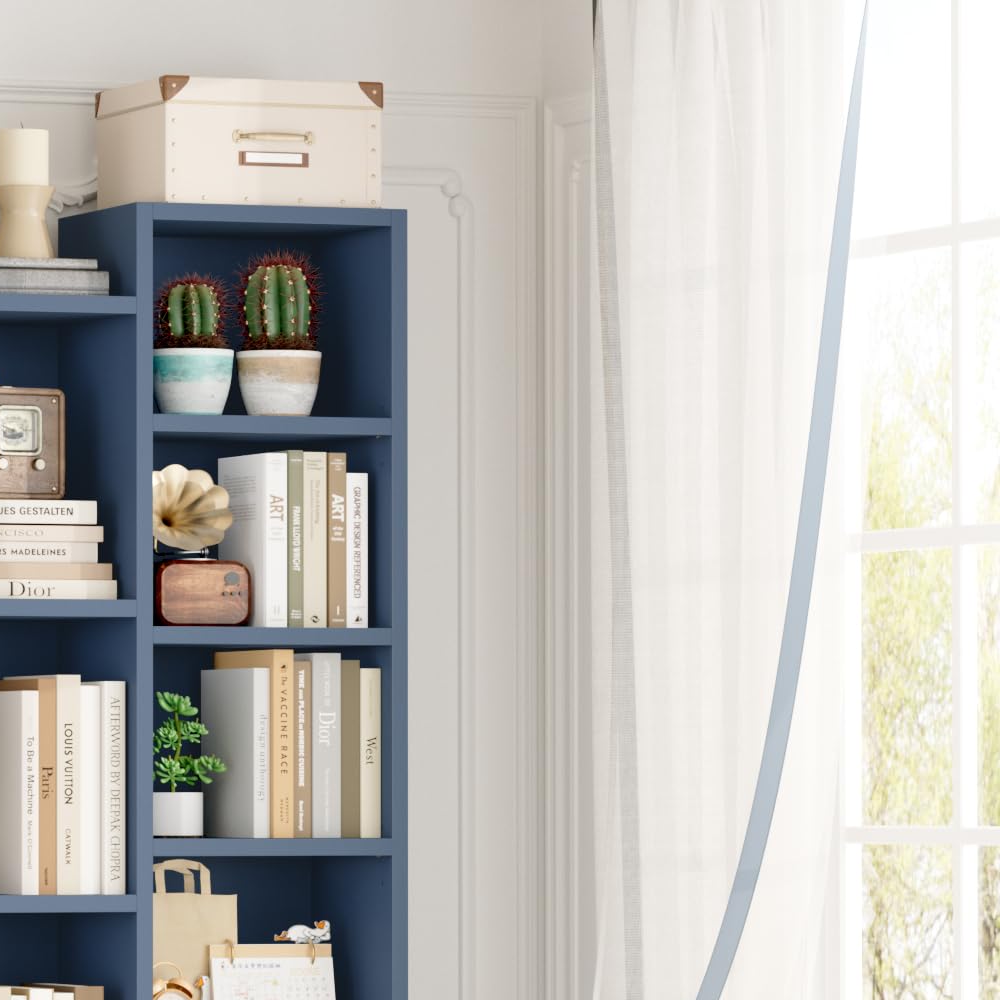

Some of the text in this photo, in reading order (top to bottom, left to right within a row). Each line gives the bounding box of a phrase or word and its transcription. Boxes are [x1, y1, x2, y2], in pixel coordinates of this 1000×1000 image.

[19, 507, 74, 516] GESTALTEN
[269, 494, 284, 522] ART
[331, 494, 345, 522] ART
[10, 548, 66, 556] MADELEINES
[353, 486, 361, 599] GRAPHIC DESIGN REFERENCED
[8, 580, 55, 597] Dior
[280, 689, 288, 739] VACCINE
[318, 711, 337, 746] Dior
[26, 736, 35, 747] To
[64, 723, 73, 756] LOUIS
[366, 736, 378, 766] West
[26, 750, 35, 763] Be
[280, 745, 288, 775] RACE
[26, 774, 36, 815] Machine
[41, 766, 54, 800] Paris
[64, 759, 73, 805] VUITTON
[110, 696, 121, 882] AFTERWORD BY DEEPAK CHOPRA
